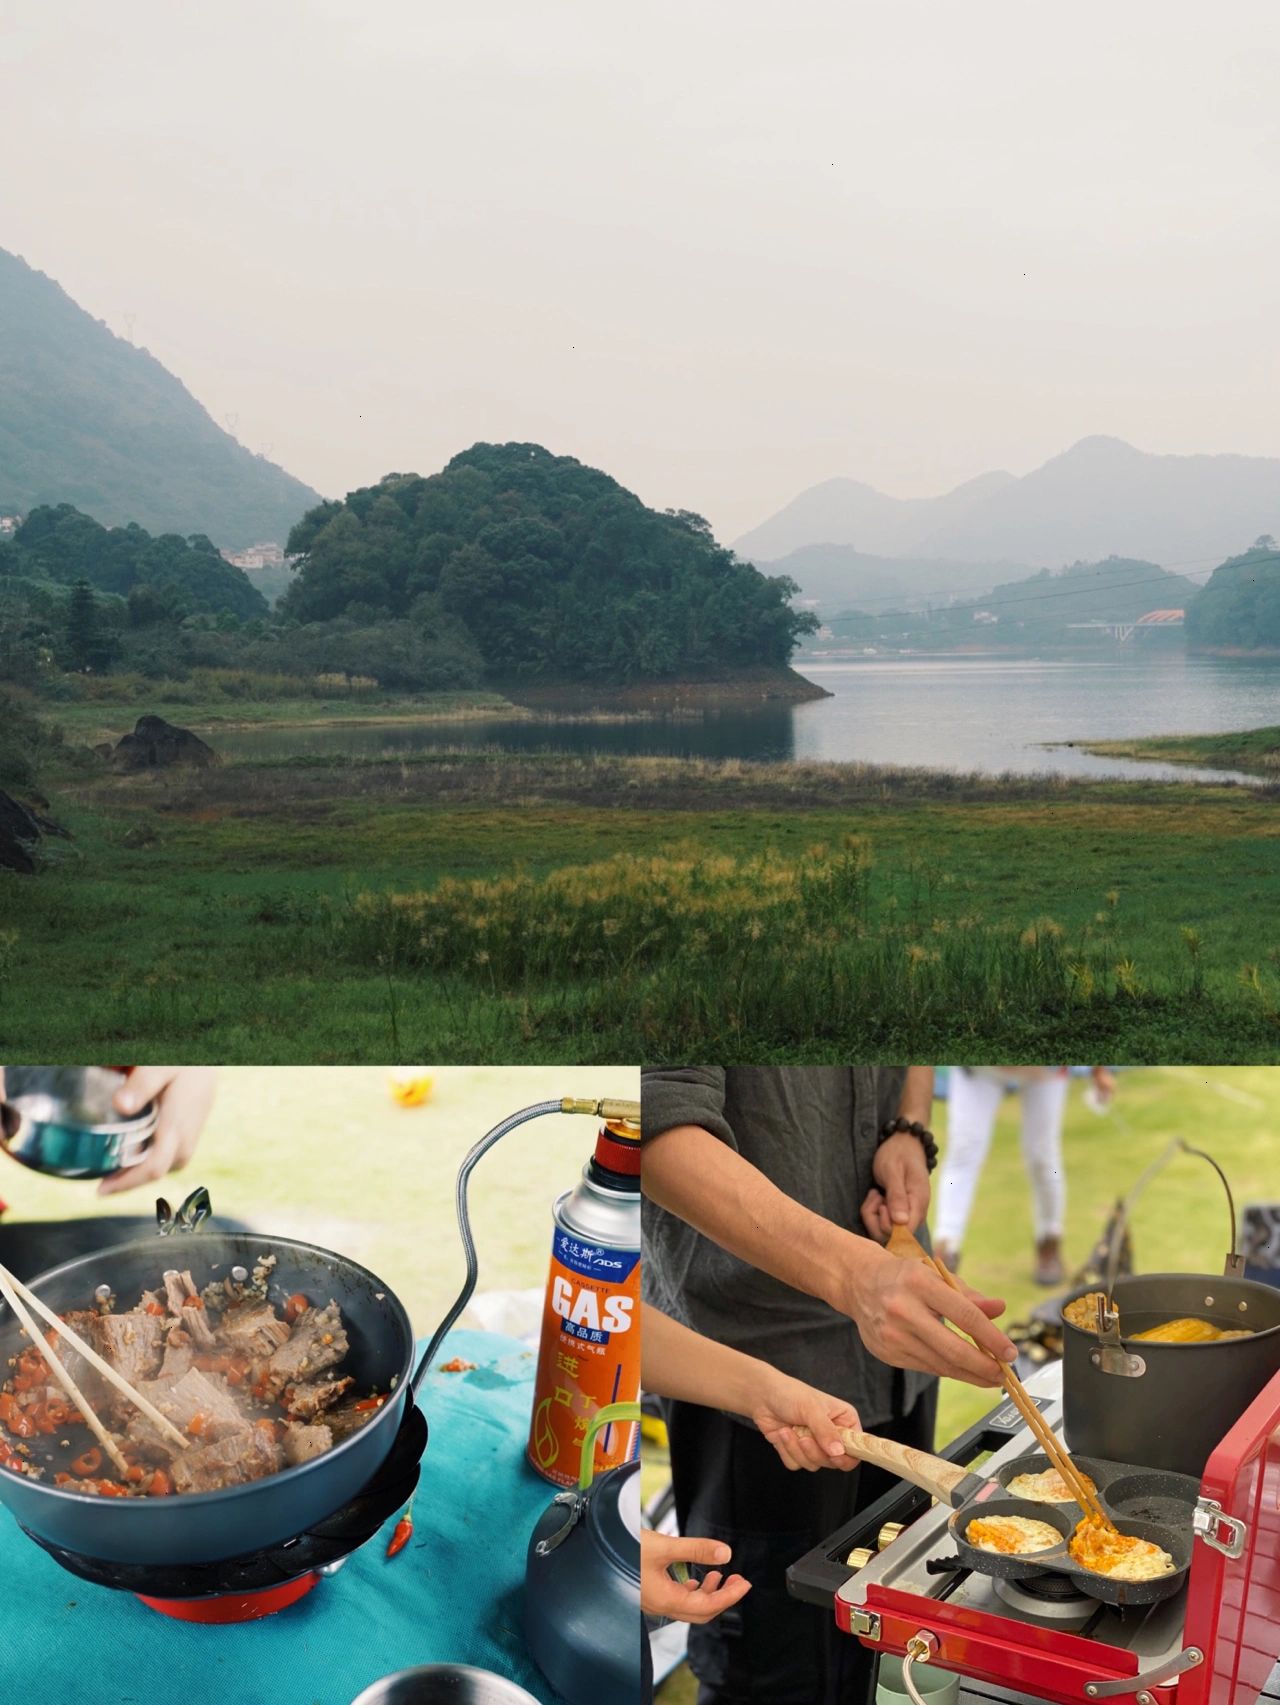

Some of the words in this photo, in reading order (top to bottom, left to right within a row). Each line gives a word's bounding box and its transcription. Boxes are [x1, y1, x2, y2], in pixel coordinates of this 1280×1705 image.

[593, 1258, 623, 1269] ADS
[571, 1278, 611, 1294] CASSETTE
[552, 1275, 634, 1334] GAS
[565, 1321, 603, 1343] 高品质
